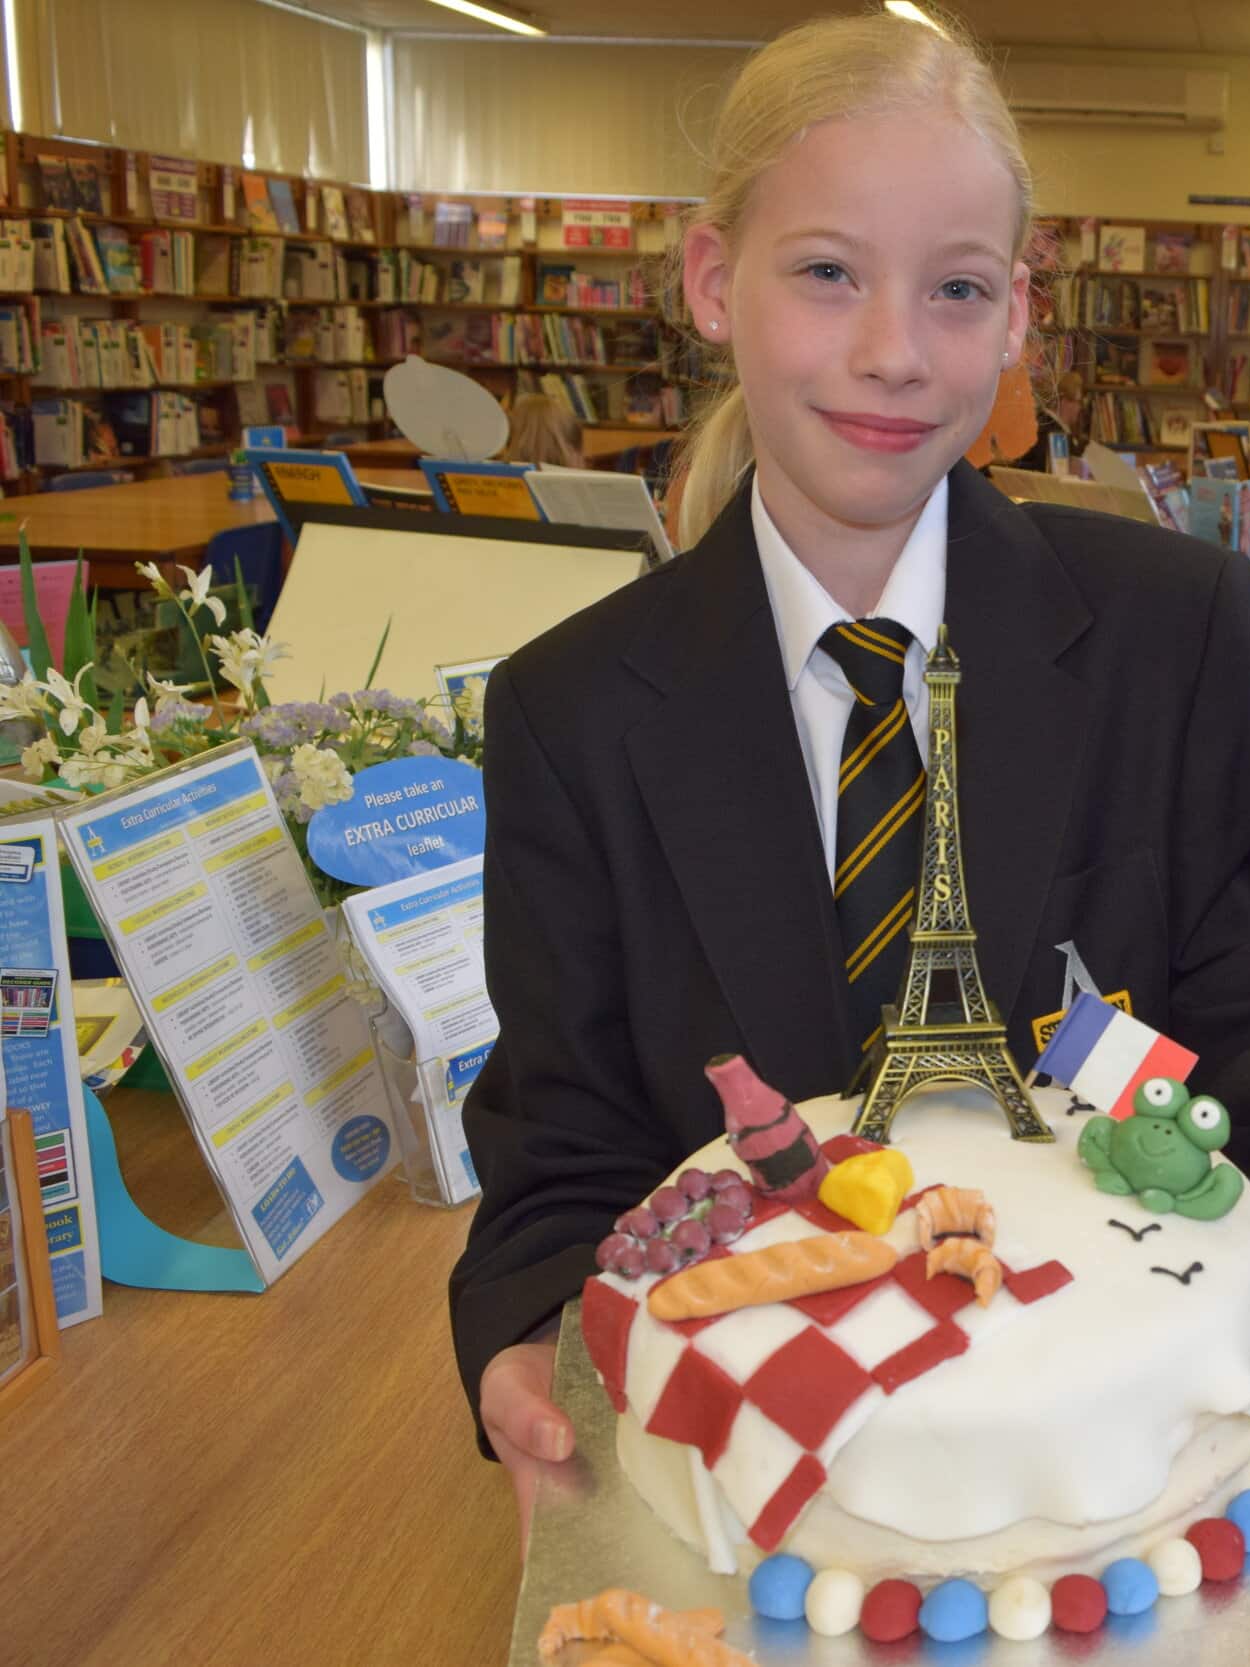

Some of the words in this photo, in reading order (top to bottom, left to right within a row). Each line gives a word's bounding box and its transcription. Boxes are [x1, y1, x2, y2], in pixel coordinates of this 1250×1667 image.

[120, 813, 145, 829] Extra
[143, 796, 182, 820] Curricular
[181, 783, 217, 805] Activities
[363, 790, 404, 809] Please
[404, 783, 429, 800] take
[431, 779, 445, 792] an
[344, 818, 396, 847] EXTRA
[396, 795, 479, 831] CURRICULAR
[933, 729, 951, 901] PARIS
[407, 834, 446, 857] leaflet
[458, 1055, 483, 1072] Extra
